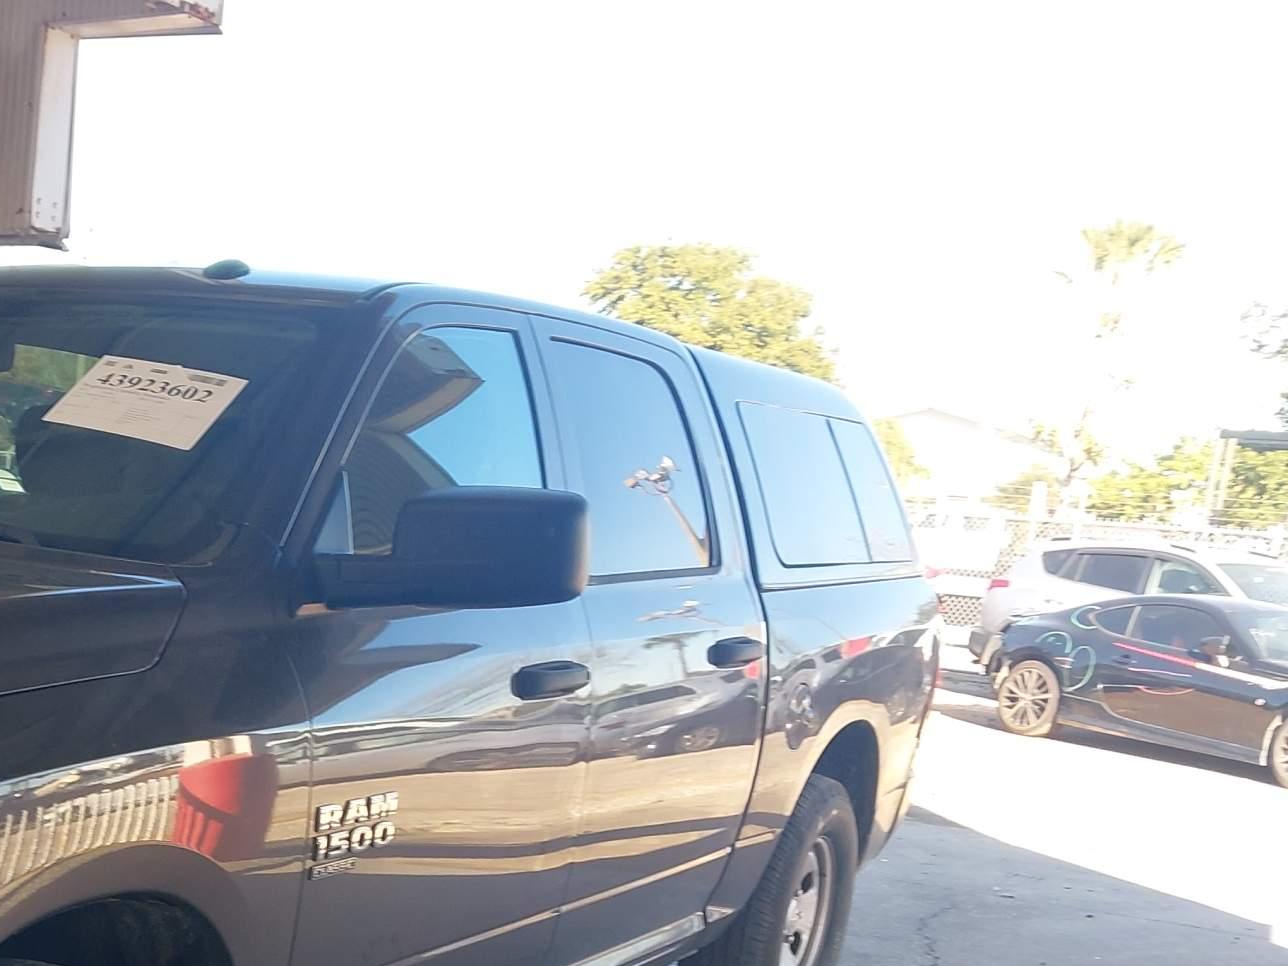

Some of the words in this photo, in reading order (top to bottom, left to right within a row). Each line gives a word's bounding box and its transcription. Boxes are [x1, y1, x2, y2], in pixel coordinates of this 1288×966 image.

[96, 372, 214, 403] 43923602
[315, 791, 399, 832] RAM
[312, 821, 395, 861] 1500
